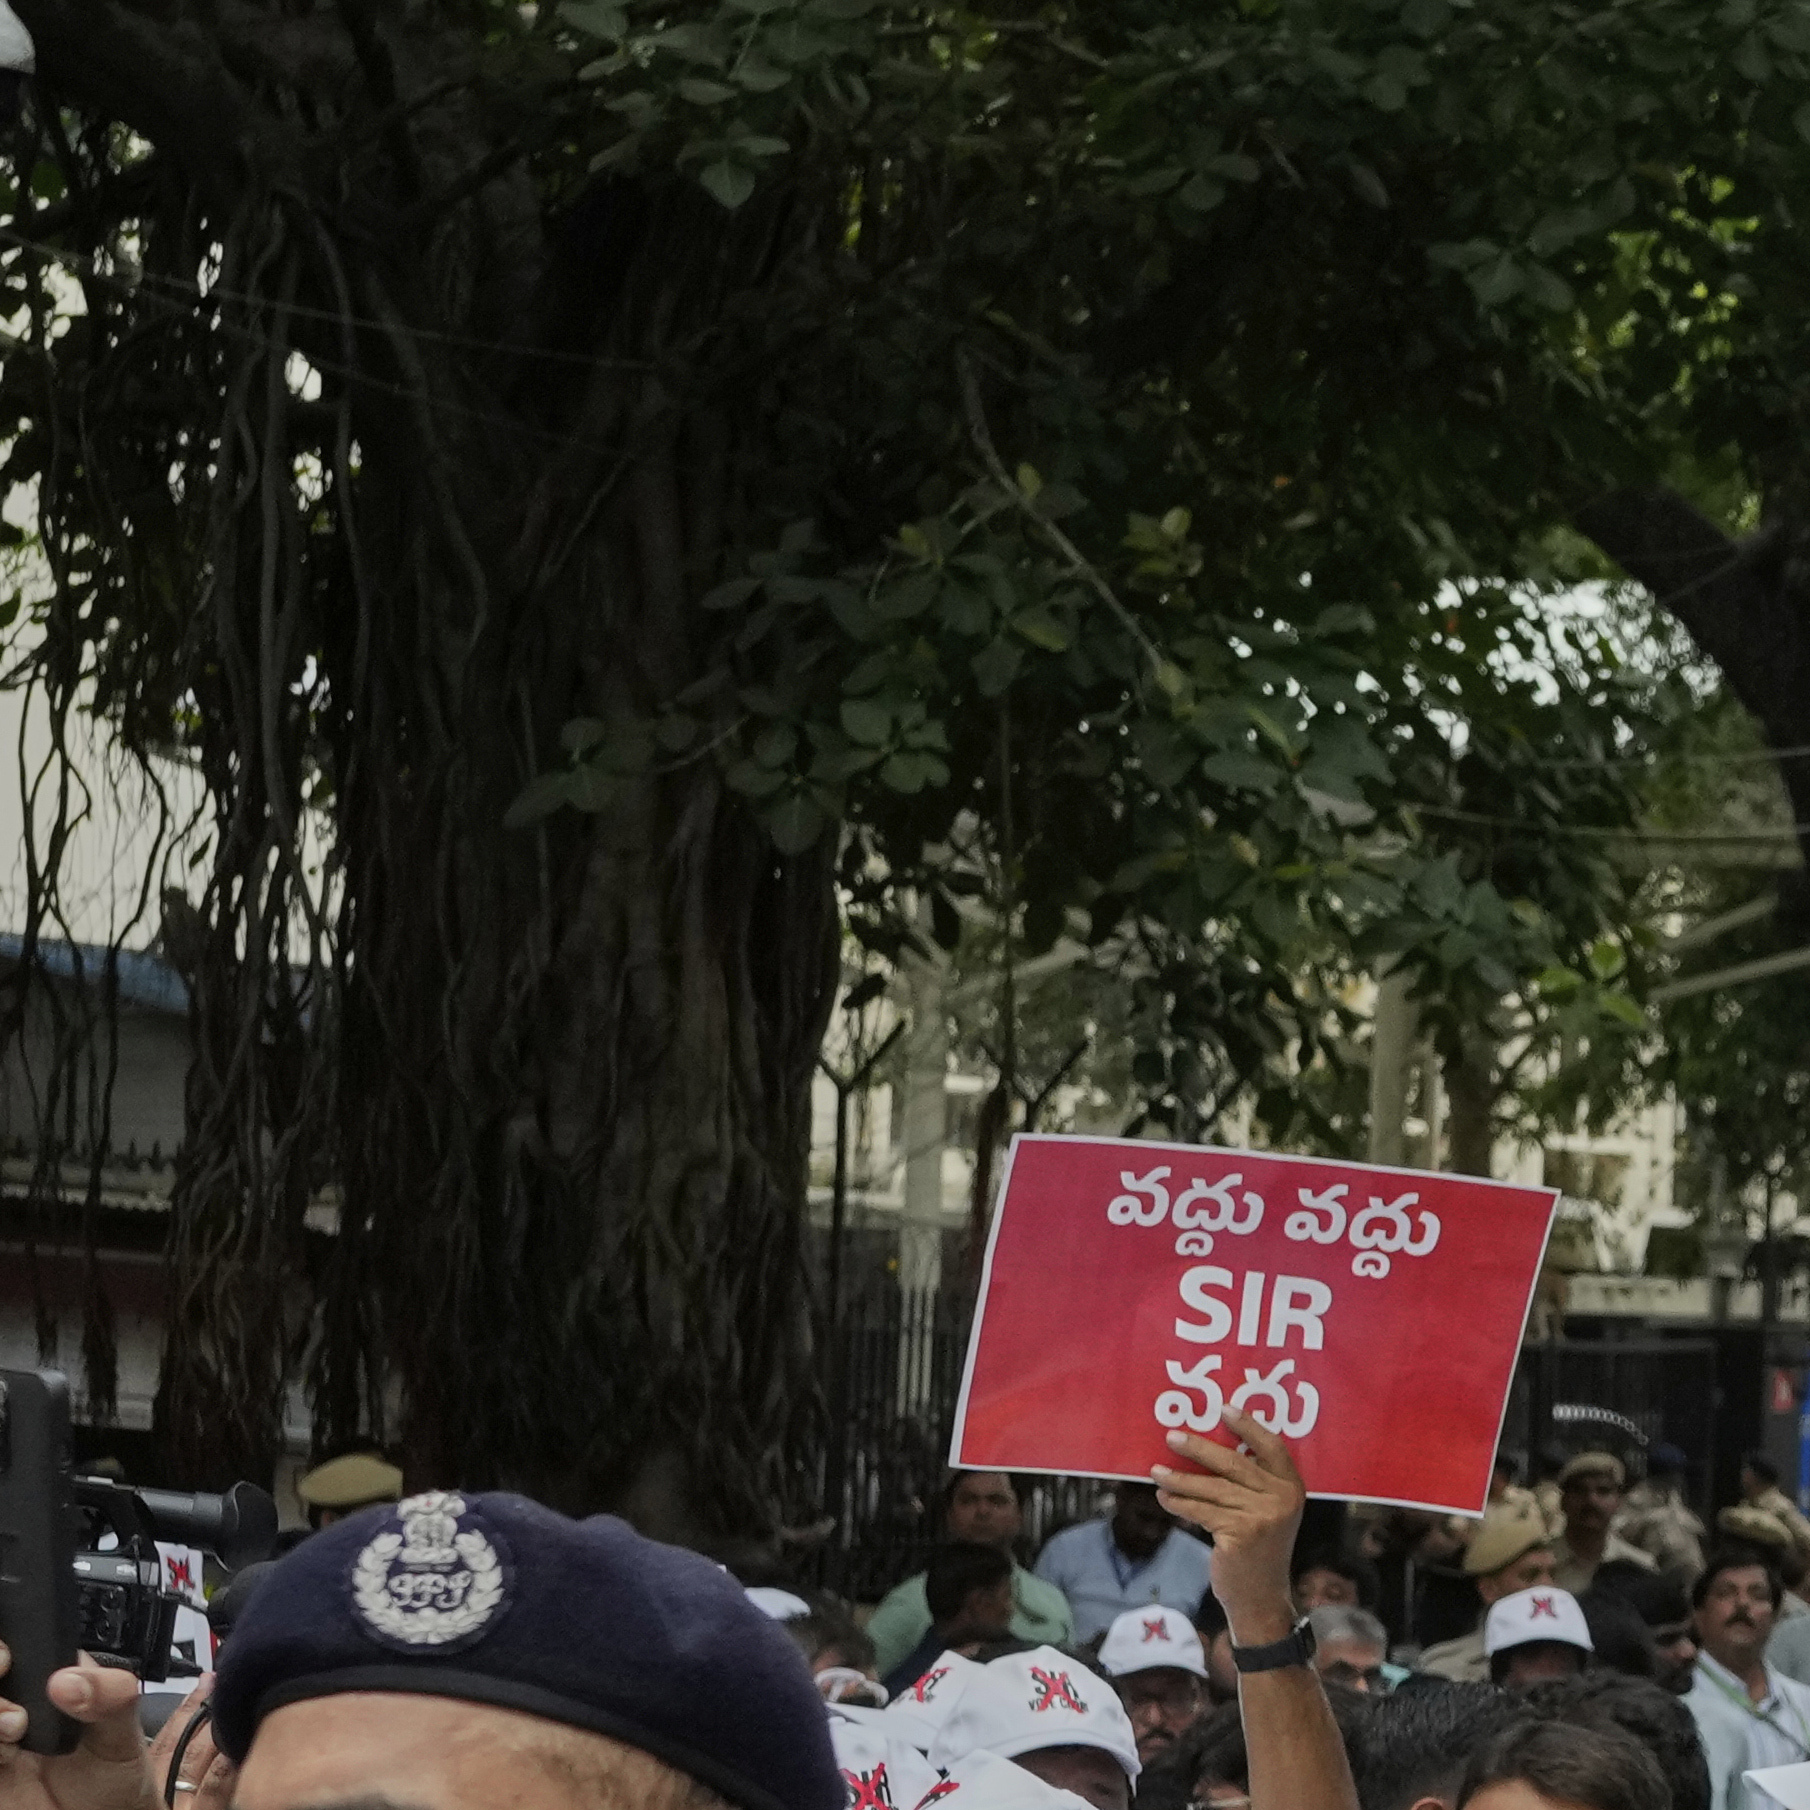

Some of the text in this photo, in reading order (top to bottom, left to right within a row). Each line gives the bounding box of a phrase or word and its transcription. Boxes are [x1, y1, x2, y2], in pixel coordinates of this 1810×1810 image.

[1107, 1166, 1441, 1280] వద్దు వద్దు
[1174, 1265, 1333, 1351] SIR
